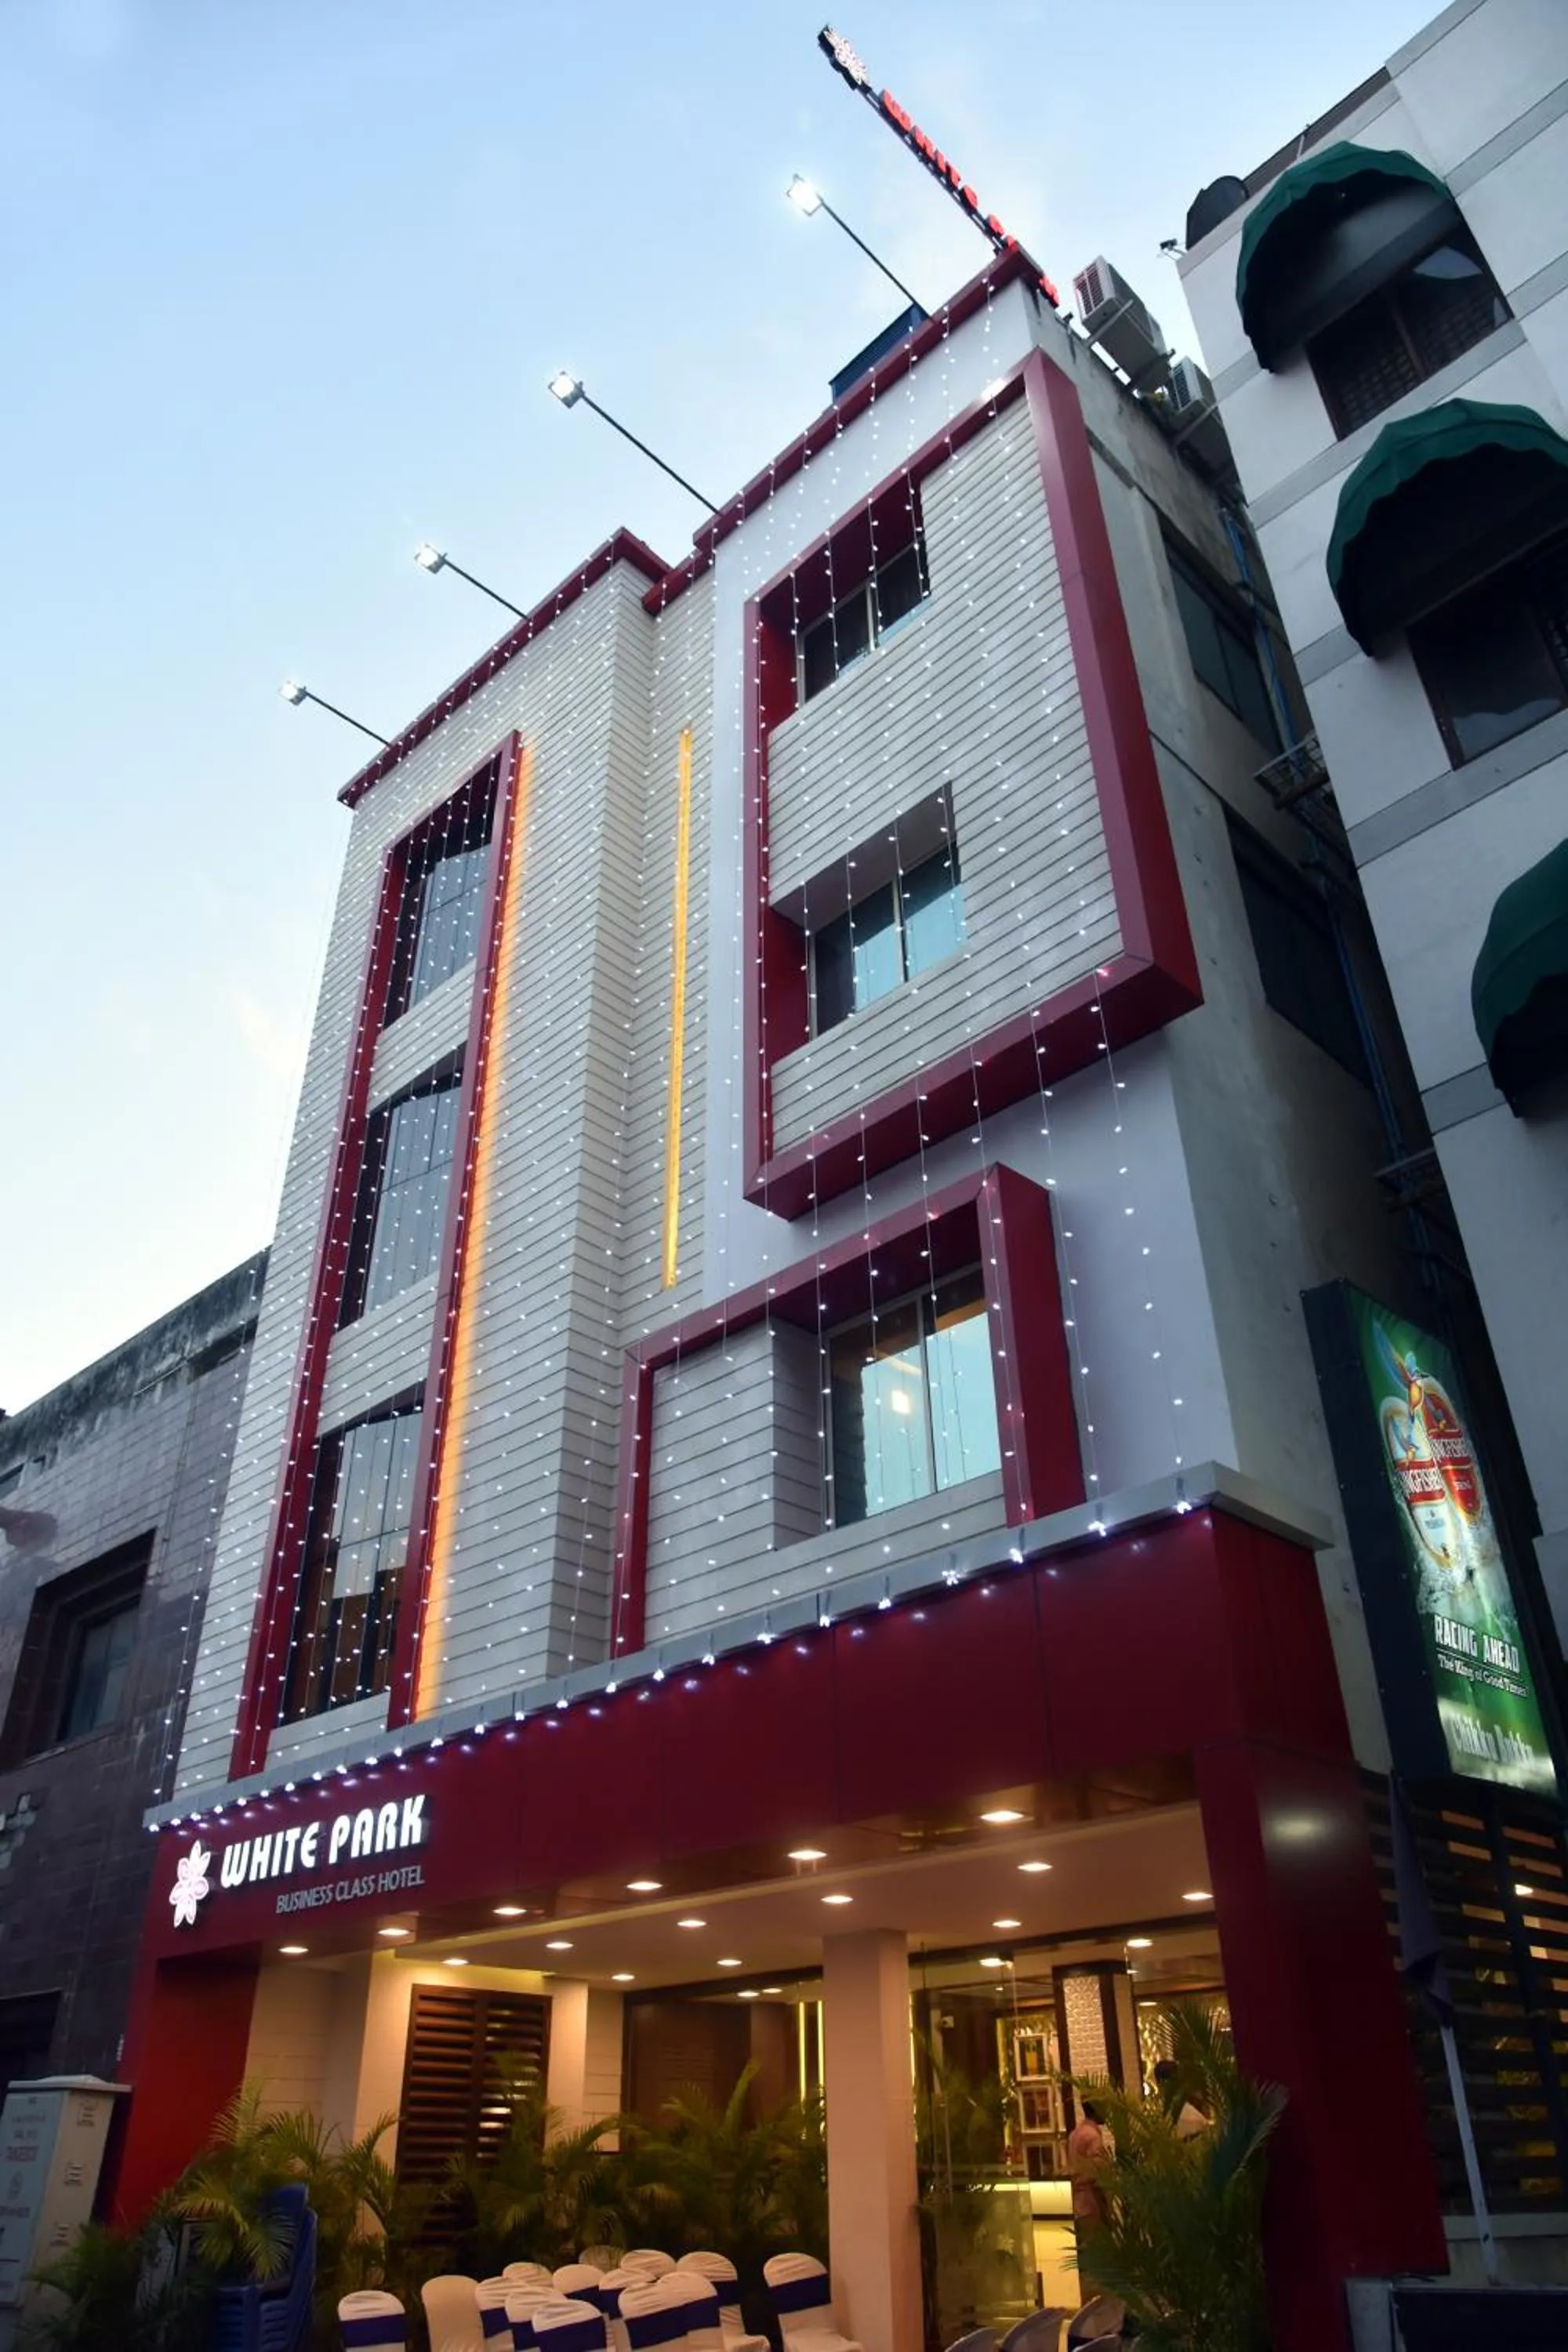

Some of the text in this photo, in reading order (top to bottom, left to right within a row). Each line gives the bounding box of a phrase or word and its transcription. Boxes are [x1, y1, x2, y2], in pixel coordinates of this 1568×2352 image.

[1434, 1614, 1520, 1674] RACING AHEAD
[1437, 1653, 1454, 1671] The
[220, 1795, 426, 1889] WHITE PARK
[276, 1865, 426, 1914] BUSINESS CLASS HOTEL
